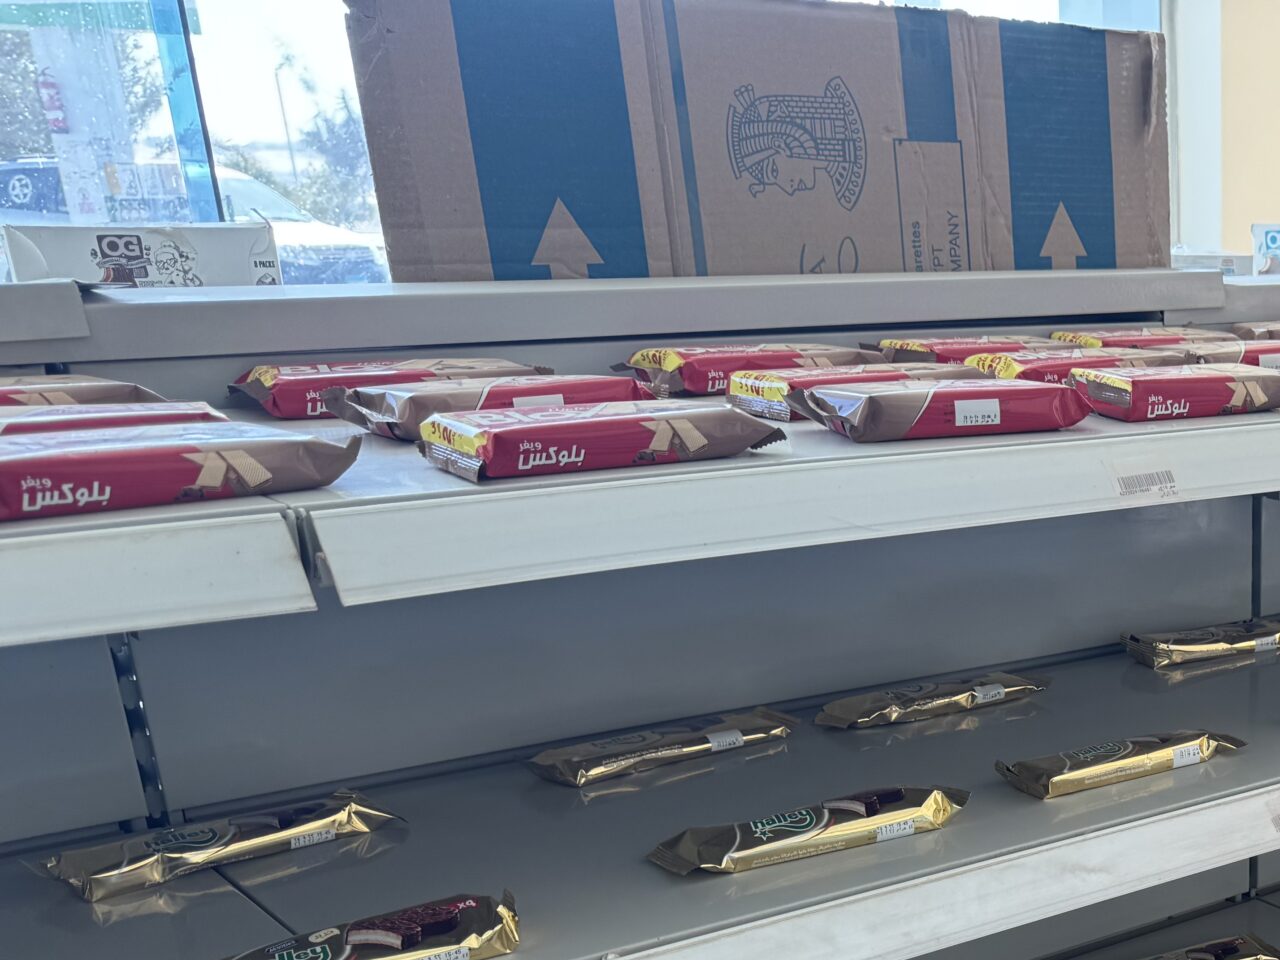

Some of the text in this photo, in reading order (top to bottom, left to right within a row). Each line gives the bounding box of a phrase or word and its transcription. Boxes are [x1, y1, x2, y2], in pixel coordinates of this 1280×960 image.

[101, 236, 139, 257] OG
[258, 260, 276, 269] PACKS
[1146, 398, 1190, 419] بلوكس
[519, 440, 542, 452] ويفر
[517, 444, 586, 471] بلوكس
[20, 477, 52, 490] ويفر
[21, 482, 112, 512] بلوكس
[1071, 740, 1125, 760] halley
[750, 808, 816, 831] halley
